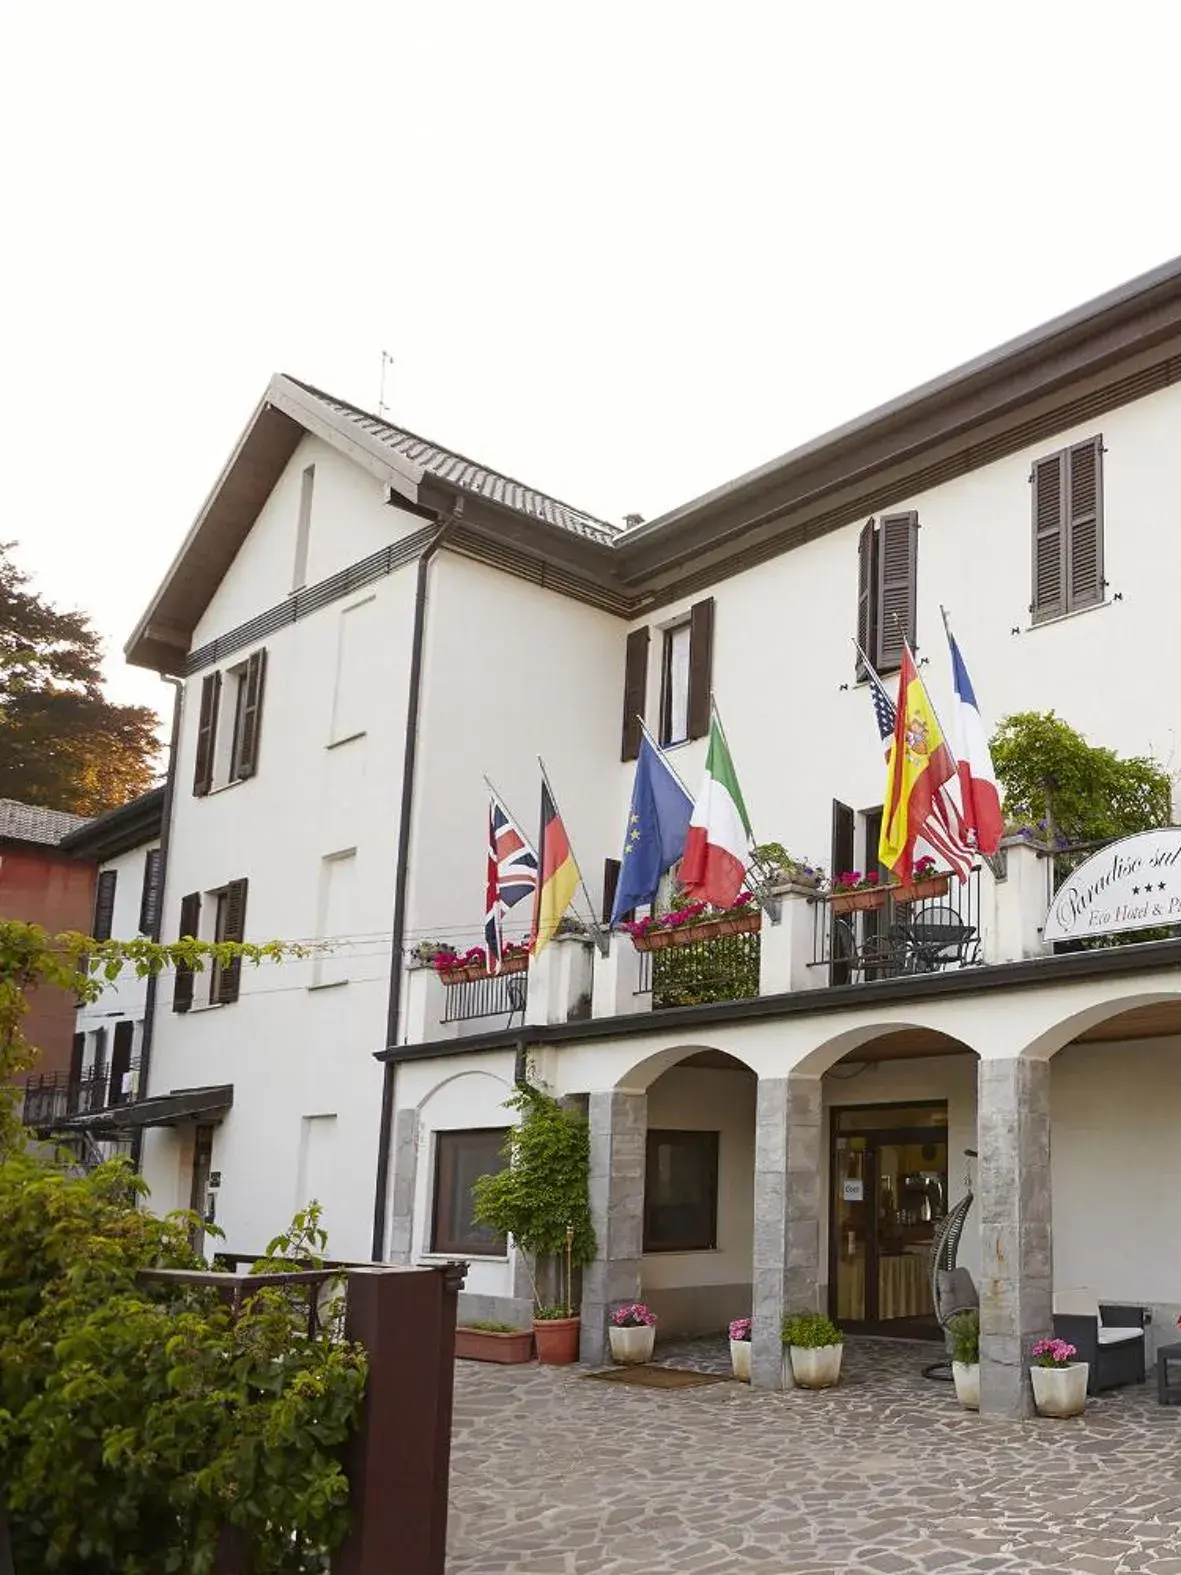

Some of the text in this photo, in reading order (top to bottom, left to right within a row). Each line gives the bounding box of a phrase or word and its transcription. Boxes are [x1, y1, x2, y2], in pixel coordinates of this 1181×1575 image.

[1056, 852, 1143, 932] Paradiso
[1088, 909, 1111, 928] Eco
[1114, 901, 1149, 923] Hotel
[1152, 903, 1163, 916] &
